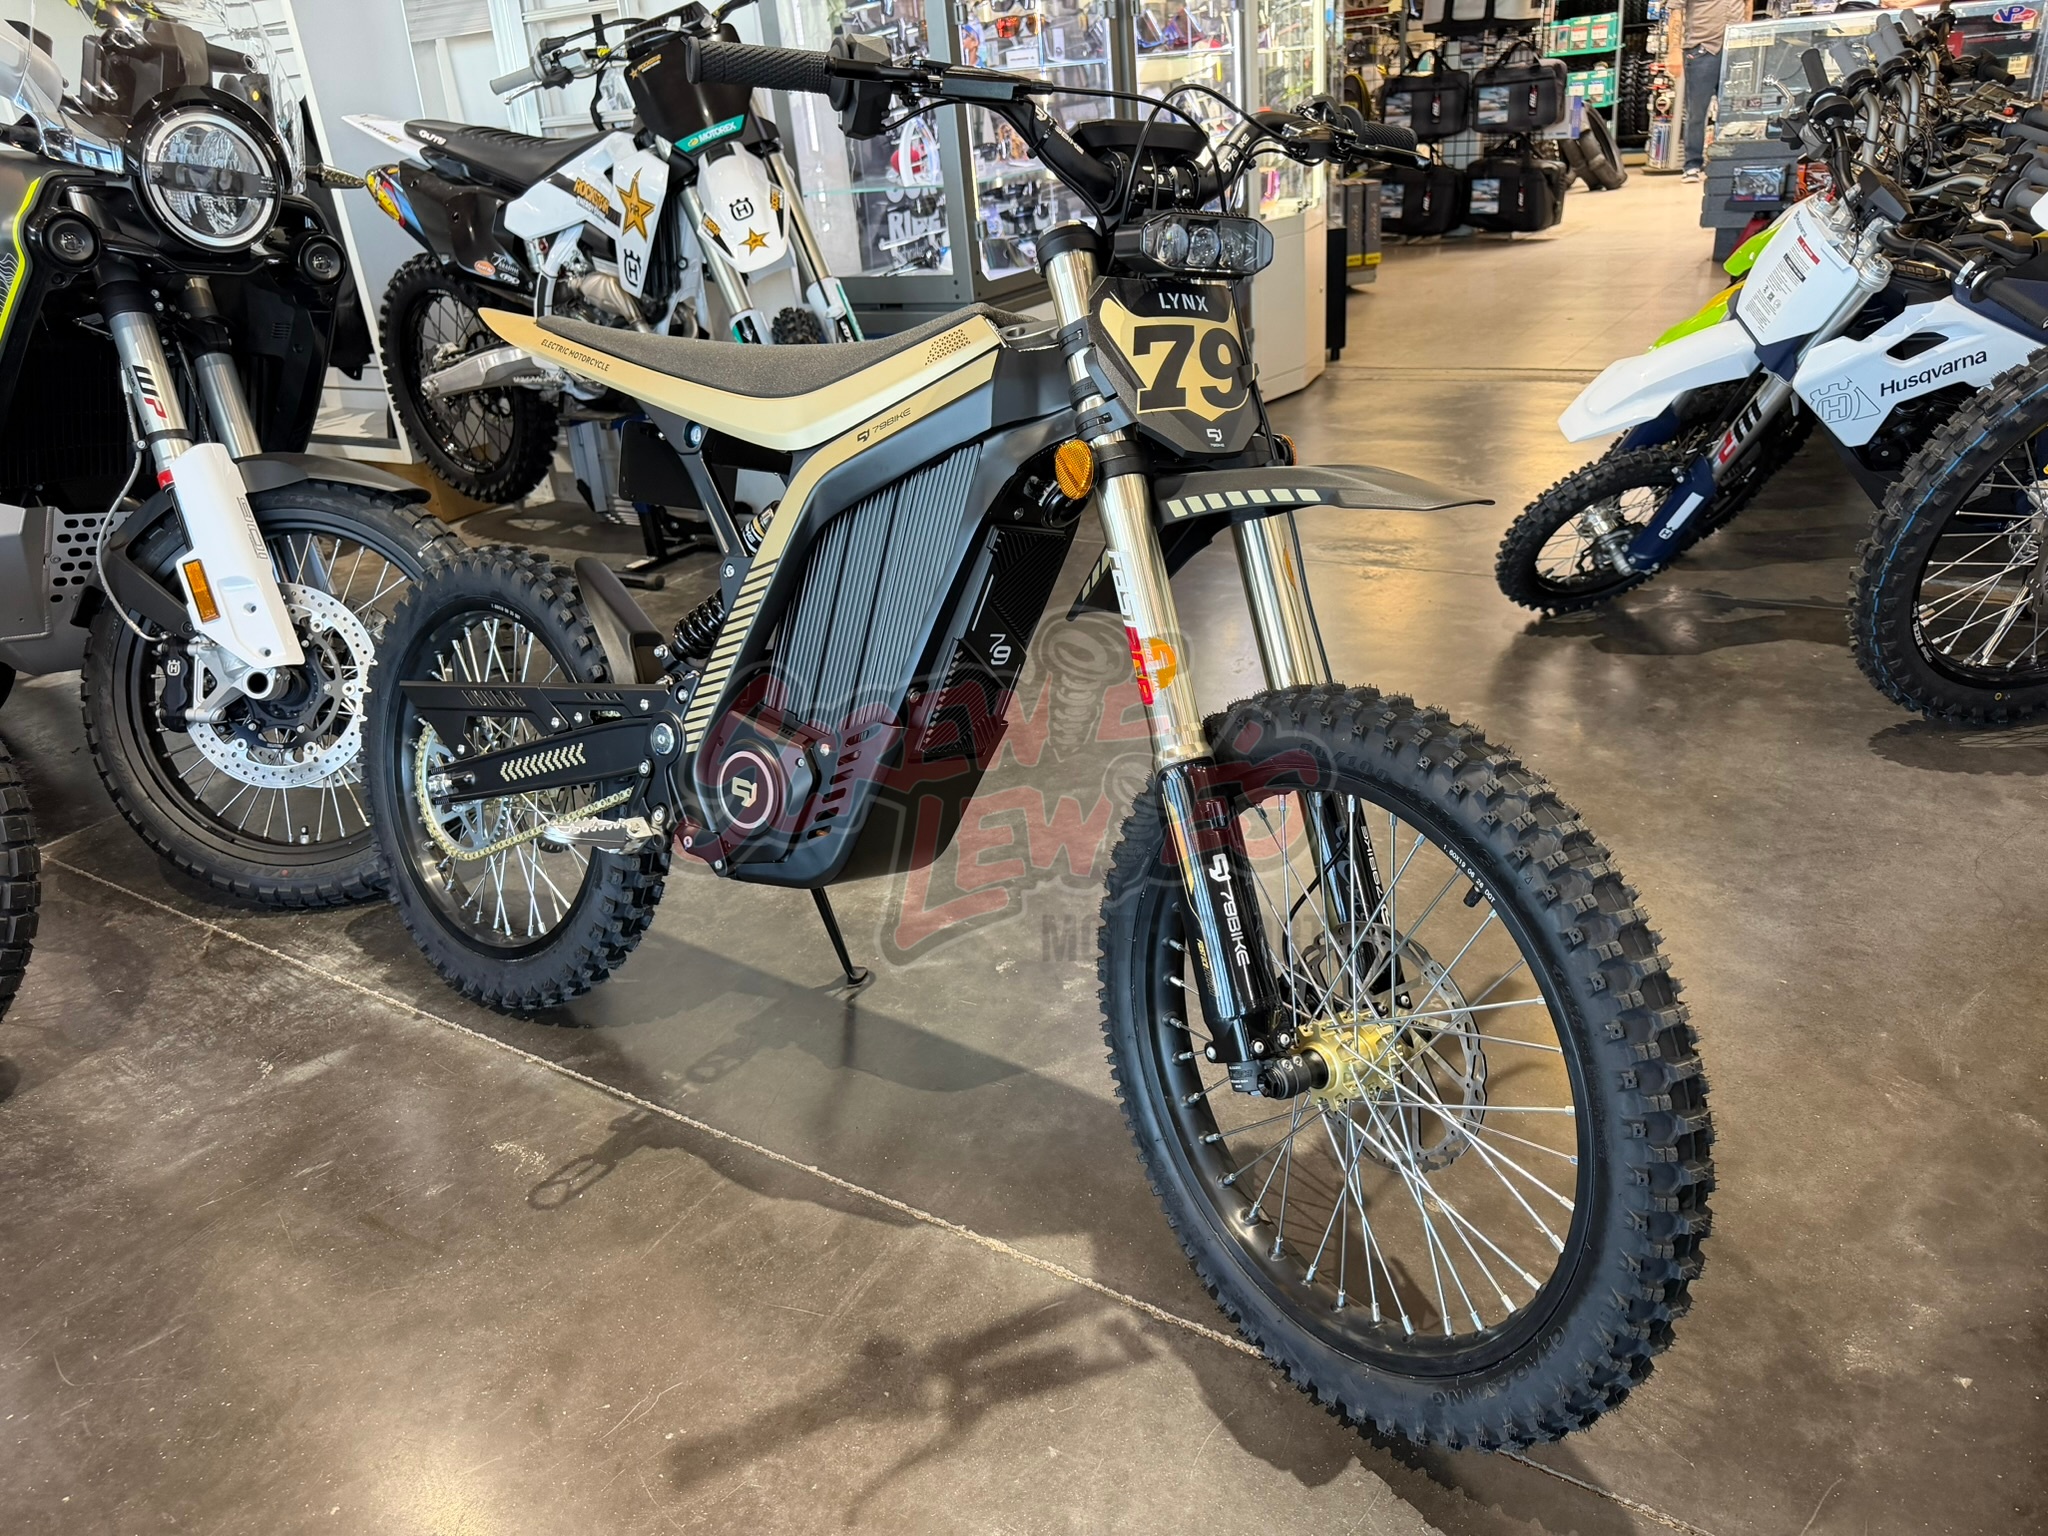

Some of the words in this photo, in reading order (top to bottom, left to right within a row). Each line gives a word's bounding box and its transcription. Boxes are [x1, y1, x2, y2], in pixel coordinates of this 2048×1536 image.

[1998, 5, 2025, 23] VP
[698, 121, 736, 143] MOTOREX
[573, 176, 611, 215] ROCKSTAR
[1158, 292, 1209, 312] LYNX
[541, 339, 570, 355] ELECTRIC
[568, 349, 611, 372] MOTORCYCLE
[1133, 324, 1249, 411] 79
[132, 365, 167, 418] WP
[1880, 350, 1988, 398] Husqvarna
[872, 407, 911, 433] 79BIKE
[1718, 396, 1763, 464] WP
[989, 633, 1012, 666] 79
[1220, 891, 1251, 967] 79BIKE
